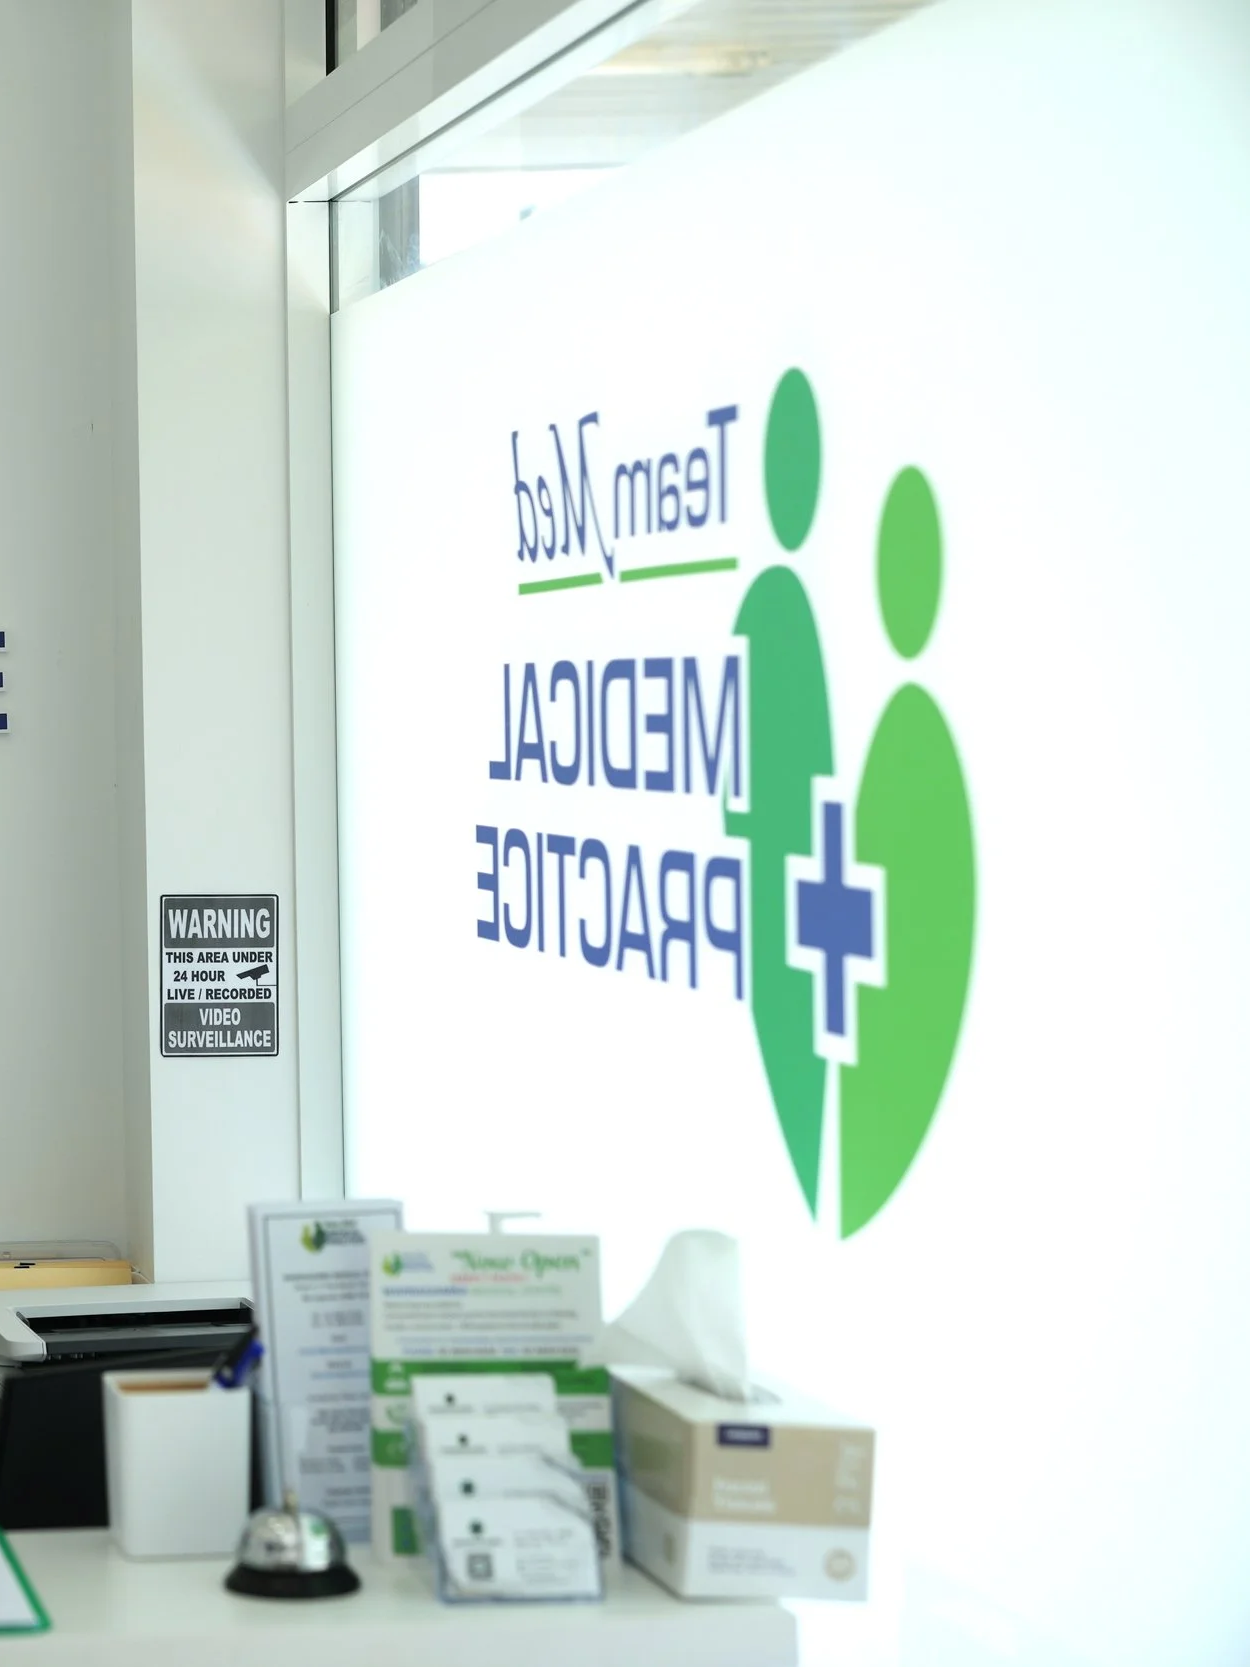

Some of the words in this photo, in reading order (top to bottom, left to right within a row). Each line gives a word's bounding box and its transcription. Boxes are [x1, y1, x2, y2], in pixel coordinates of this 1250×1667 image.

[168, 908, 270, 939] WARNING
[166, 952, 194, 963] THIS
[197, 952, 229, 963] AREA
[232, 952, 273, 963] UNDER
[173, 970, 187, 982] 24
[191, 970, 225, 982] HOUR
[167, 988, 195, 1000] LIVE
[205, 988, 272, 1000] RECORDED
[199, 1008, 241, 1026] VIDEO
[168, 1030, 271, 1048] SURVEILLANCE
